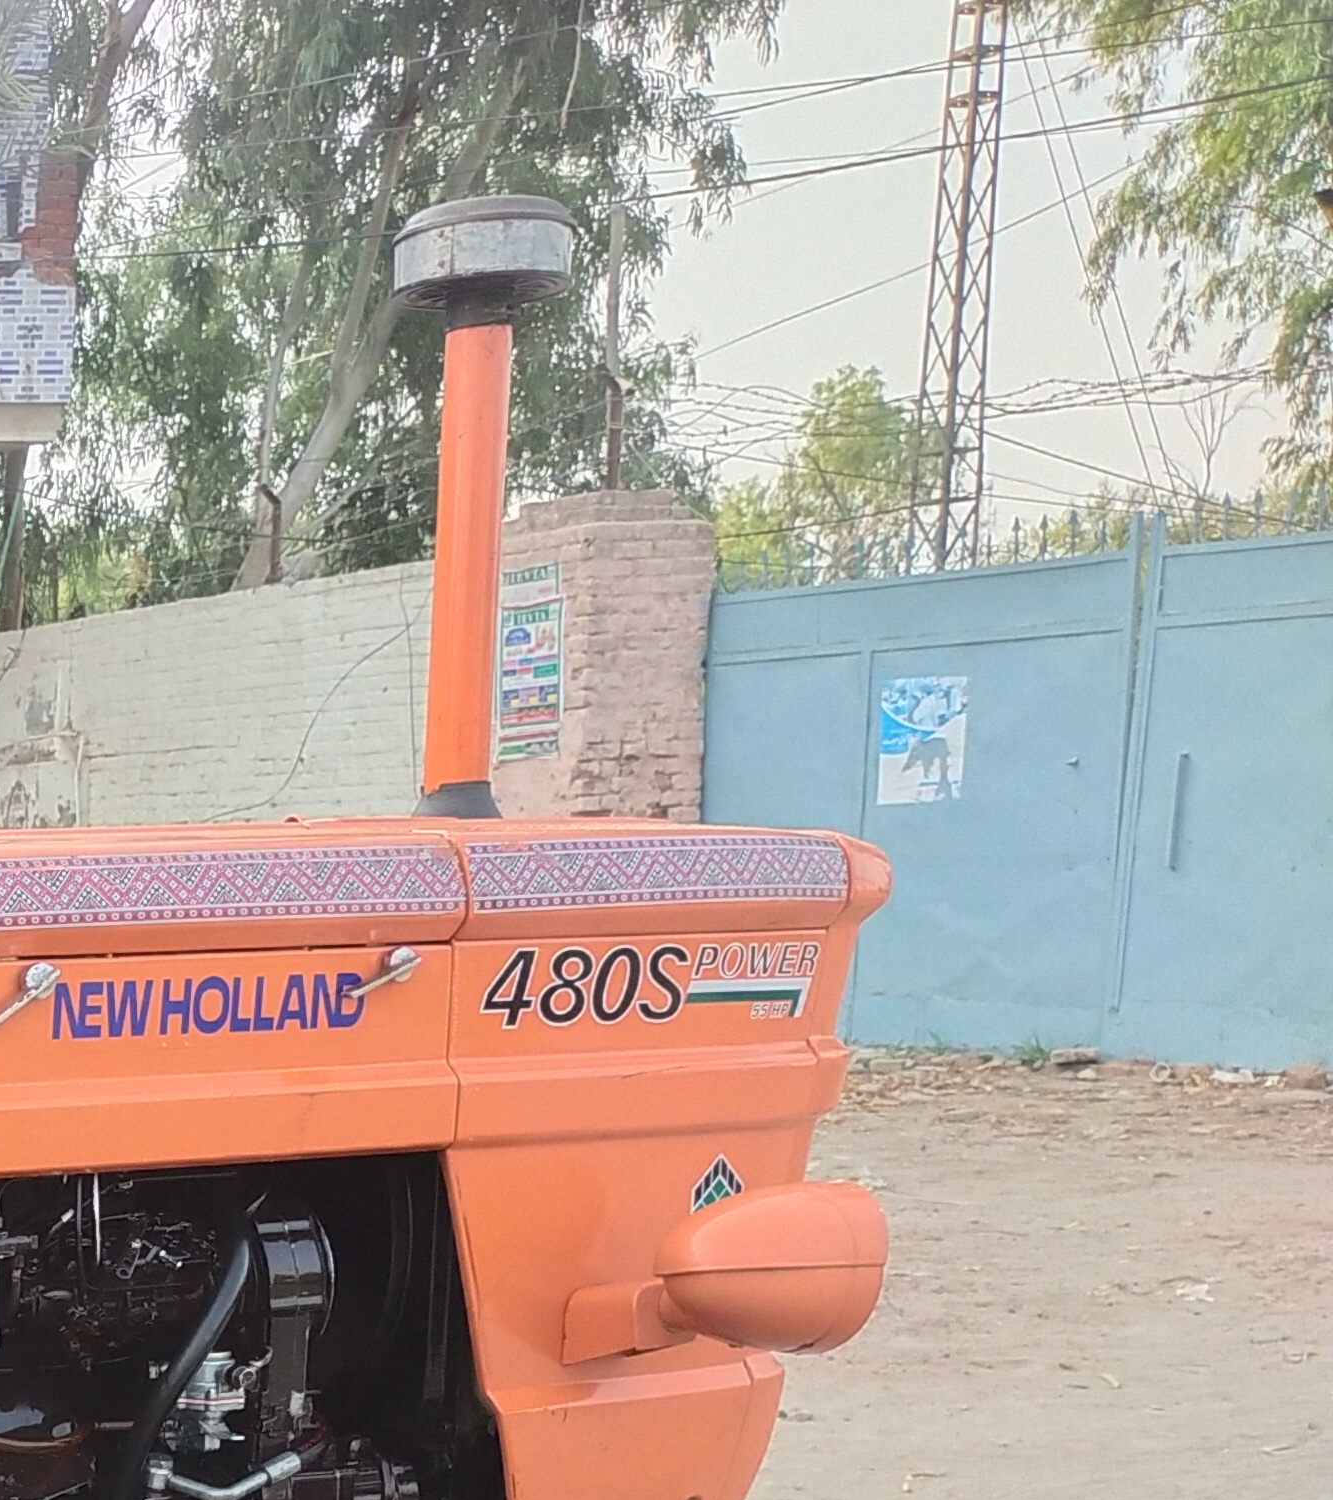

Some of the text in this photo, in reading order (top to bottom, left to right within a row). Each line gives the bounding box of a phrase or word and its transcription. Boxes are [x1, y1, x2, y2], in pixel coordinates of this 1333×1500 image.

[51, 972, 366, 1041] NEW HOLLAND
[481, 942, 820, 1028] 480S POWER
[750, 1002, 790, 1019] 55 HP
